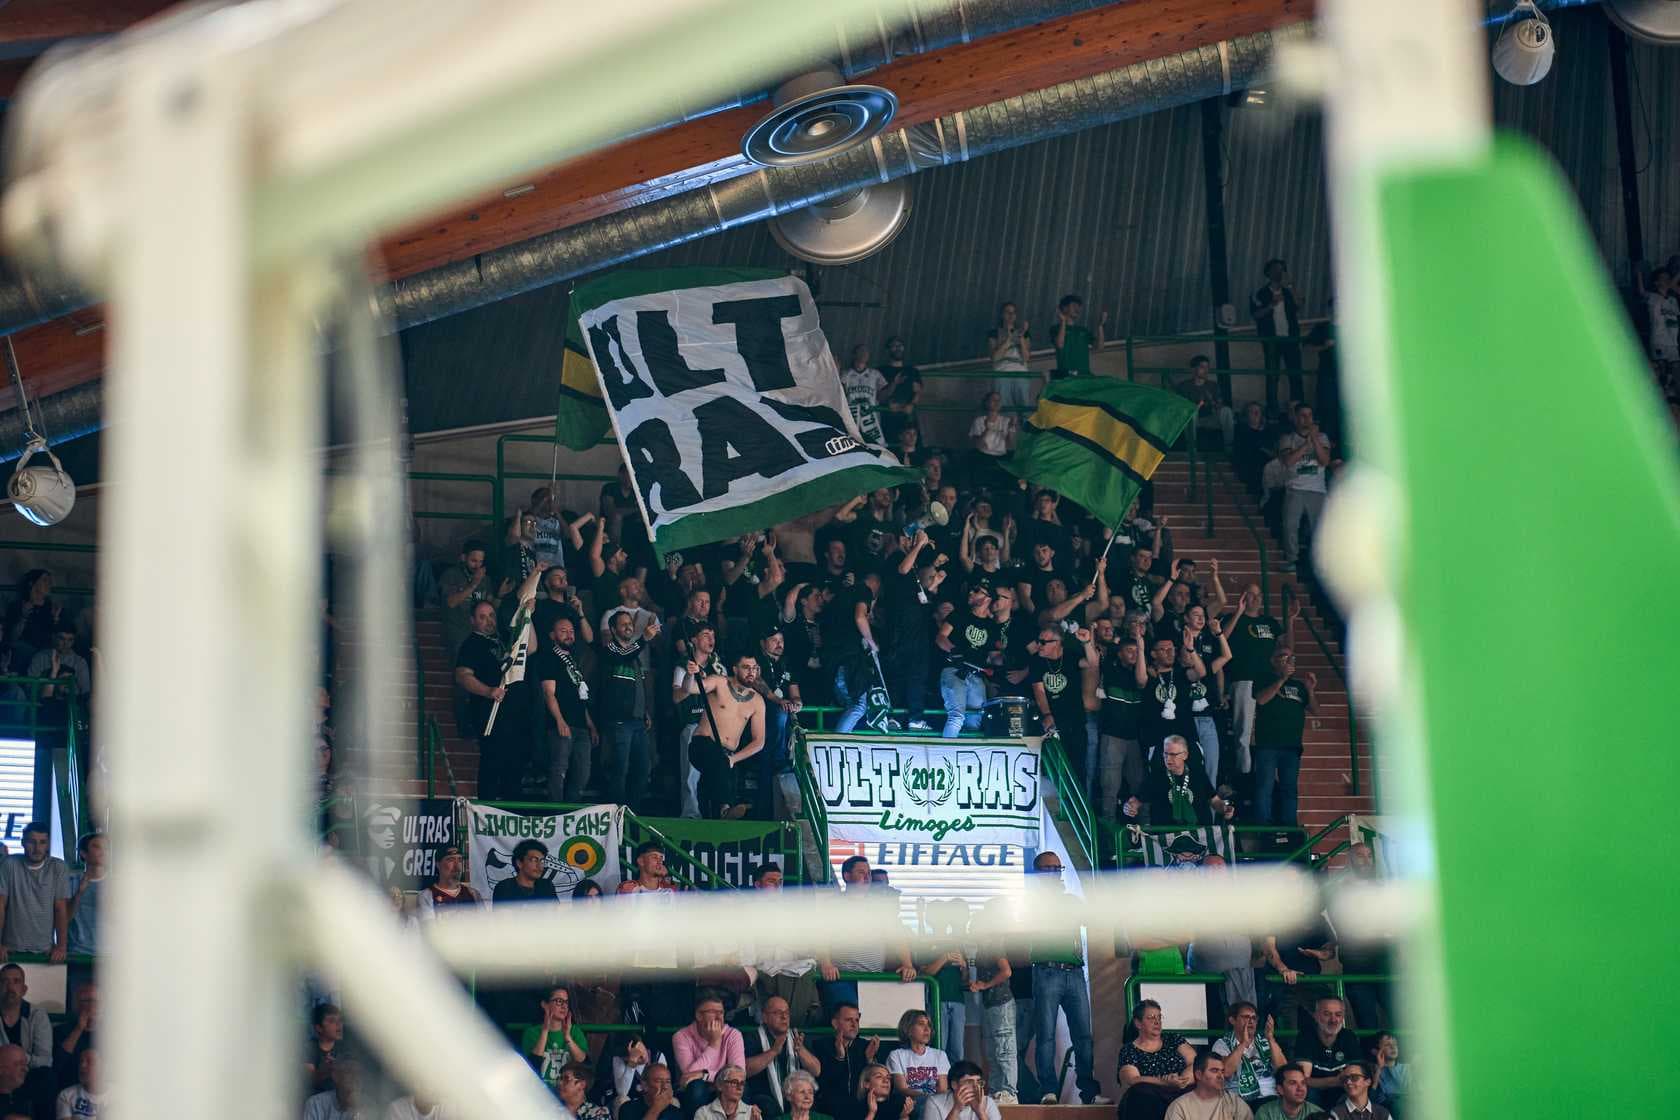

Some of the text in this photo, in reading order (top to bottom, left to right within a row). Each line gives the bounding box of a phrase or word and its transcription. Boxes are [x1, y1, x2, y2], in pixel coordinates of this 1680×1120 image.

[588, 294, 801, 412] ULT
[814, 746, 1039, 811] ULT RAS
[911, 767, 945, 791] 2012
[403, 815, 451, 844] ULTRAS
[473, 810, 611, 838] LIMOGES FANS
[878, 809, 976, 841] Limoges
[876, 843, 1015, 867] EIFFAGE
